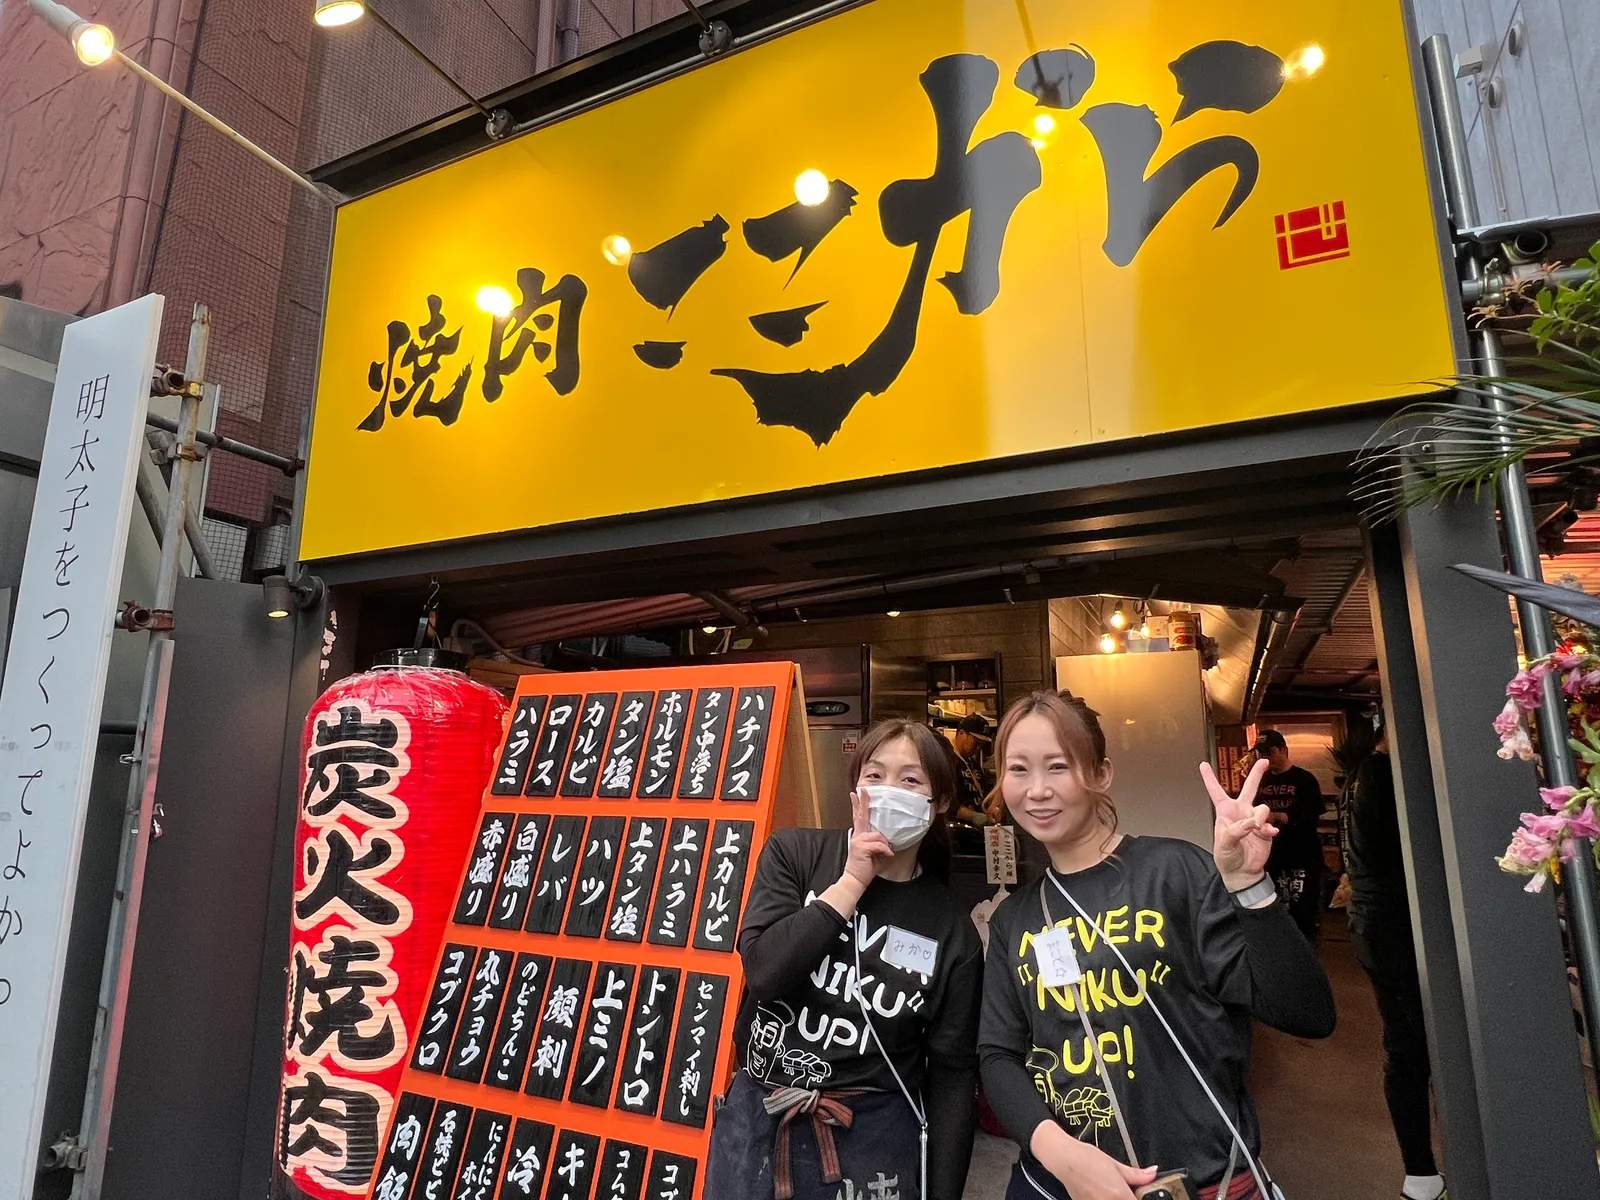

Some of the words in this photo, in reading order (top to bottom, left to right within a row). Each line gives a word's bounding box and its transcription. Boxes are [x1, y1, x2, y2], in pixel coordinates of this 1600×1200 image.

[356, 266, 588, 433] 焼肉
[498, 706, 537, 785] ハラミ
[532, 704, 573, 786] ロース
[569, 700, 606, 785] カルビ
[601, 699, 644, 790] タン塩
[645, 691, 683, 794] ホルモン
[689, 690, 722, 795] タン中落ち
[727, 694, 765, 797] ハチノス
[465, 818, 506, 917] 赤盛り
[500, 821, 539, 921] 白盛り
[537, 833, 572, 901] レバ
[579, 838, 612, 906] ハツ
[610, 821, 654, 937] 上タン塩
[658, 824, 699, 938] 上ハラミ
[704, 826, 741, 942] 上カルビ
[280, 704, 401, 1187] 炭火焼肉
[418, 950, 465, 1067] コブクロ
[458, 950, 501, 1066] 丸チョウ
[497, 961, 539, 1081] のどちんこ
[531, 984, 580, 1079] 顔刺
[581, 969, 626, 1086] 上ミノ
[623, 969, 667, 1107] トントロ
[678, 980, 714, 1117] センマイ刺し
[1062, 1024, 1136, 1080] UP!
[506, 1145, 541, 1194] 冷
